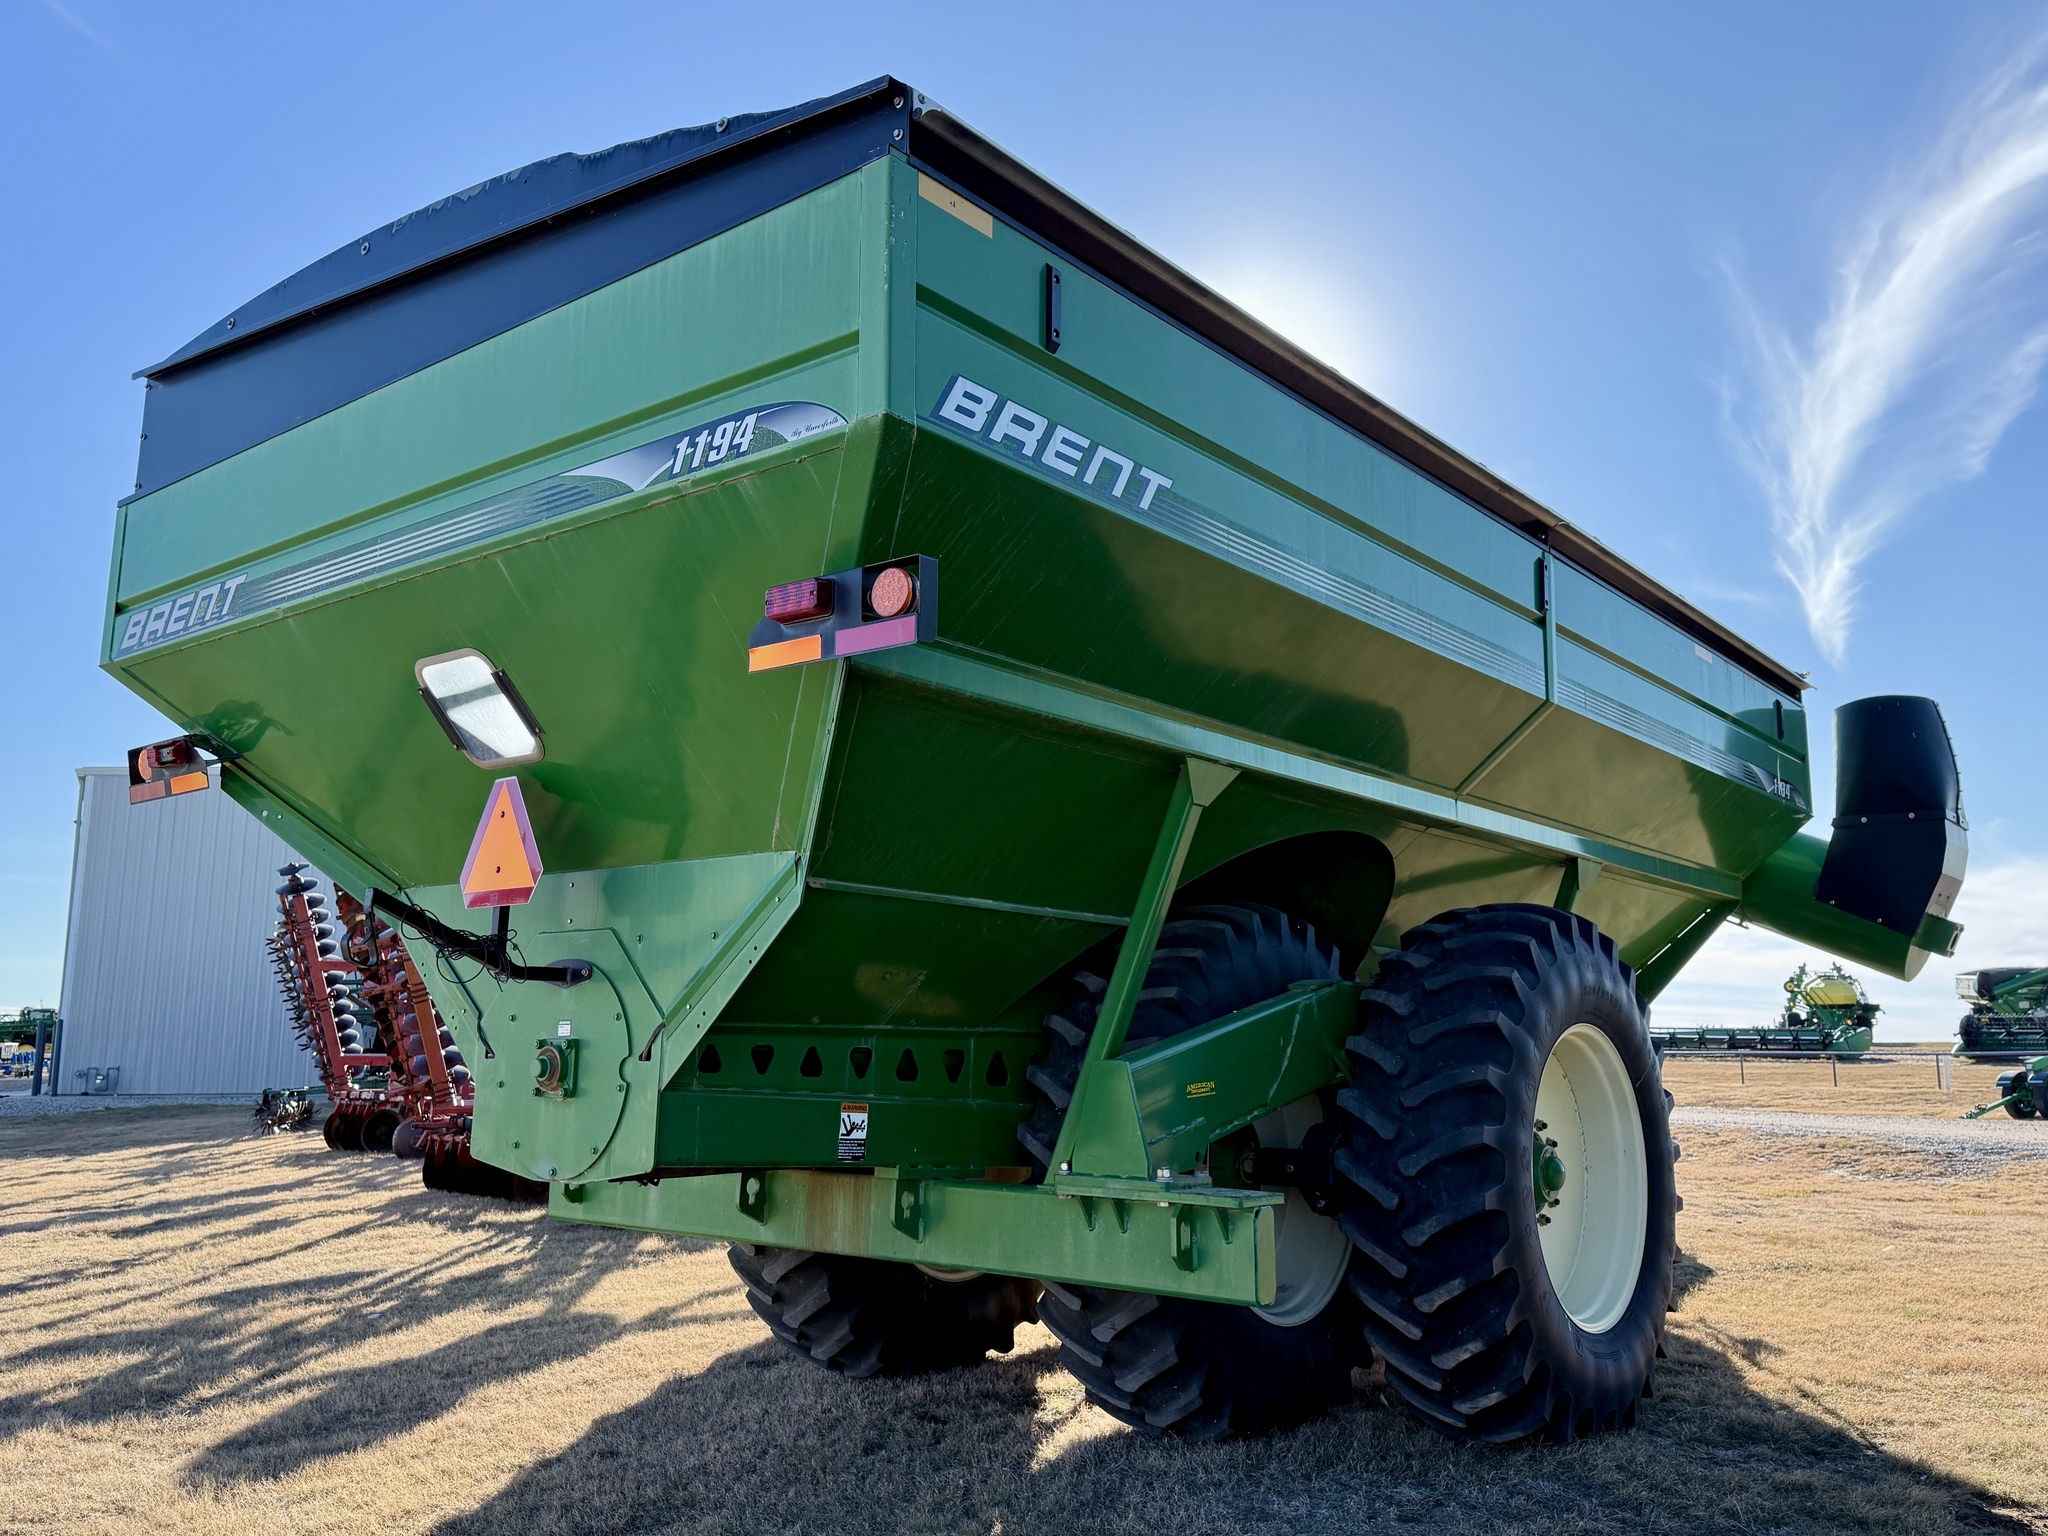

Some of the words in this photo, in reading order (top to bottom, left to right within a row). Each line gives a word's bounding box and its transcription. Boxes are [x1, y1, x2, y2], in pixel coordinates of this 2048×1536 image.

[672, 413, 759, 474] 1194
[938, 375, 1174, 511] BRENT
[120, 573, 248, 650] BRENT
[1186, 1081, 1215, 1093] AMERICAN
